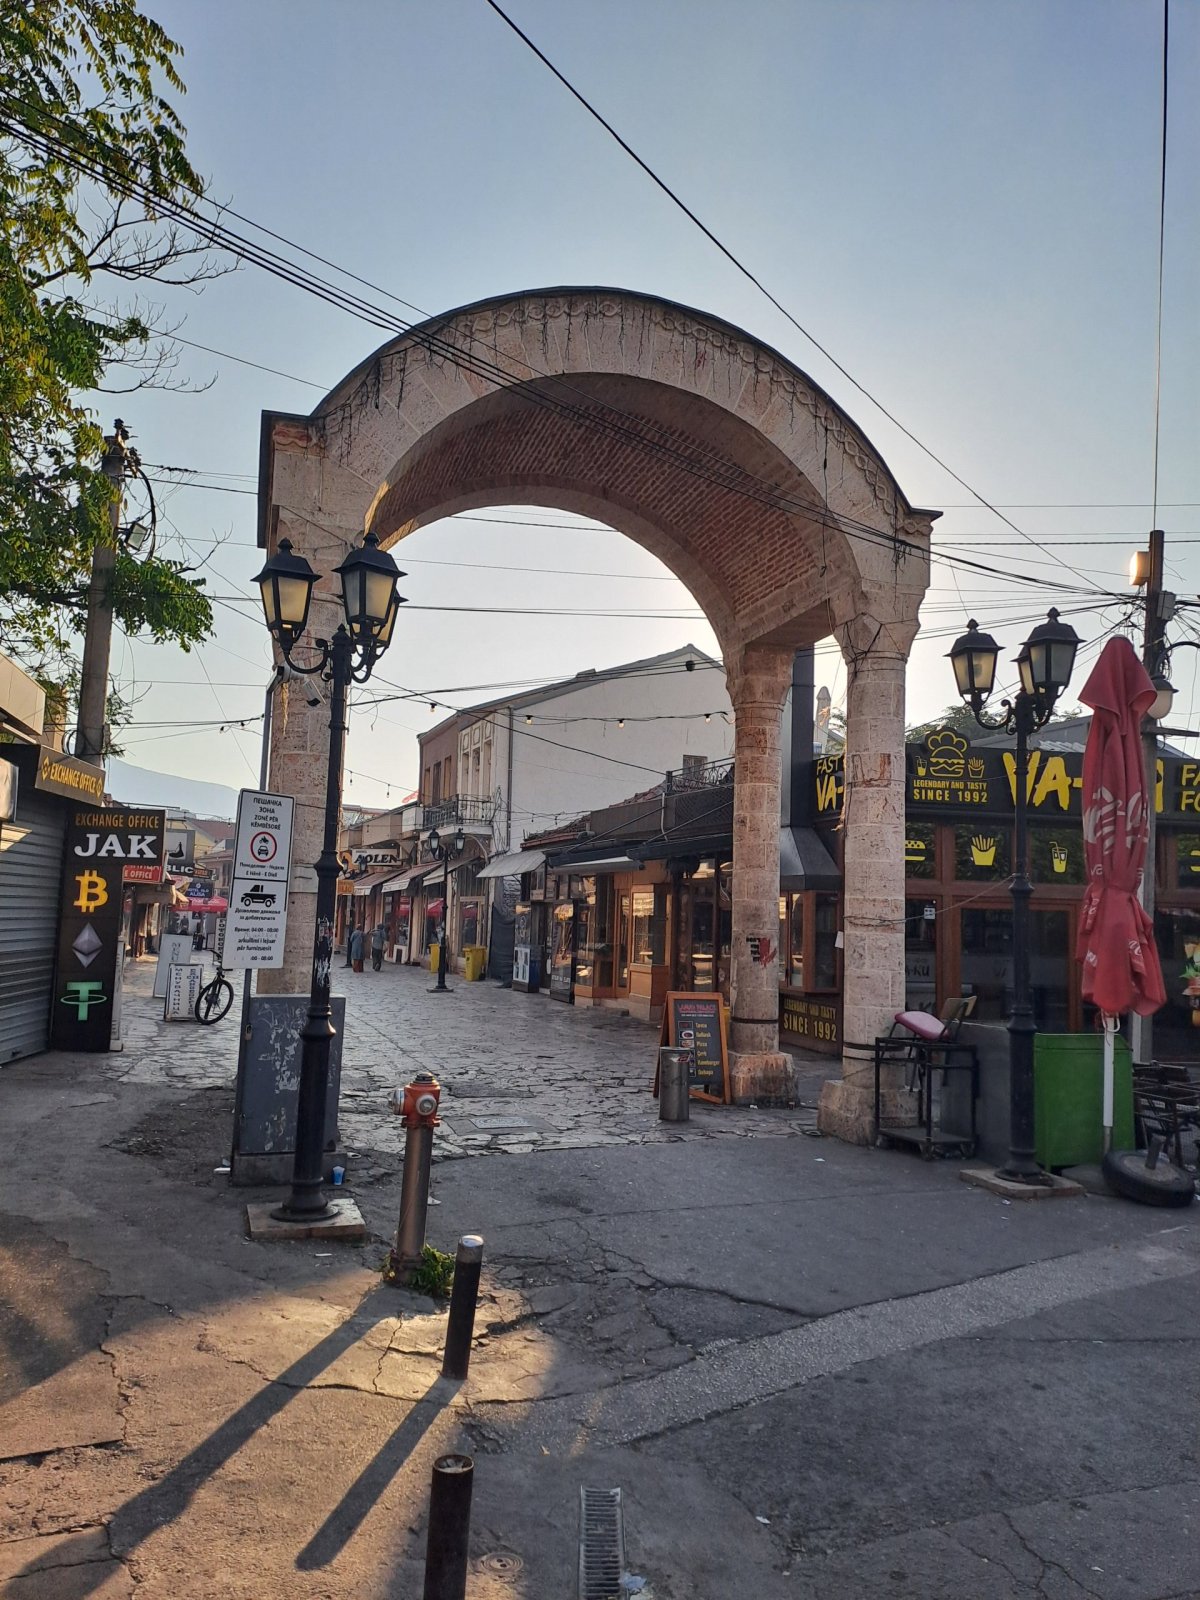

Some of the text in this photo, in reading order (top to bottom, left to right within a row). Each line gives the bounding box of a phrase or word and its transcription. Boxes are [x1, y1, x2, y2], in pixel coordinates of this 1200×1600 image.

[816, 755, 841, 776] FAST
[50, 763, 97, 793] EXCHANGE OFFICE
[913, 779, 988, 790] LEGENDARY AND TASTY
[253, 797, 282, 807] ПЕШАЧКА
[816, 775, 844, 811] VA-
[913, 789, 988, 803] SINCE 1992
[75, 813, 159, 829] EXCHANGE OFFICE
[74, 833, 158, 859] JAK
[130, 870, 153, 880] OFFICE
[784, 998, 808, 1014] LEGENDARY
[820, 1005, 837, 1020] TASTY
[783, 1012, 837, 1042] SINCE 1992
